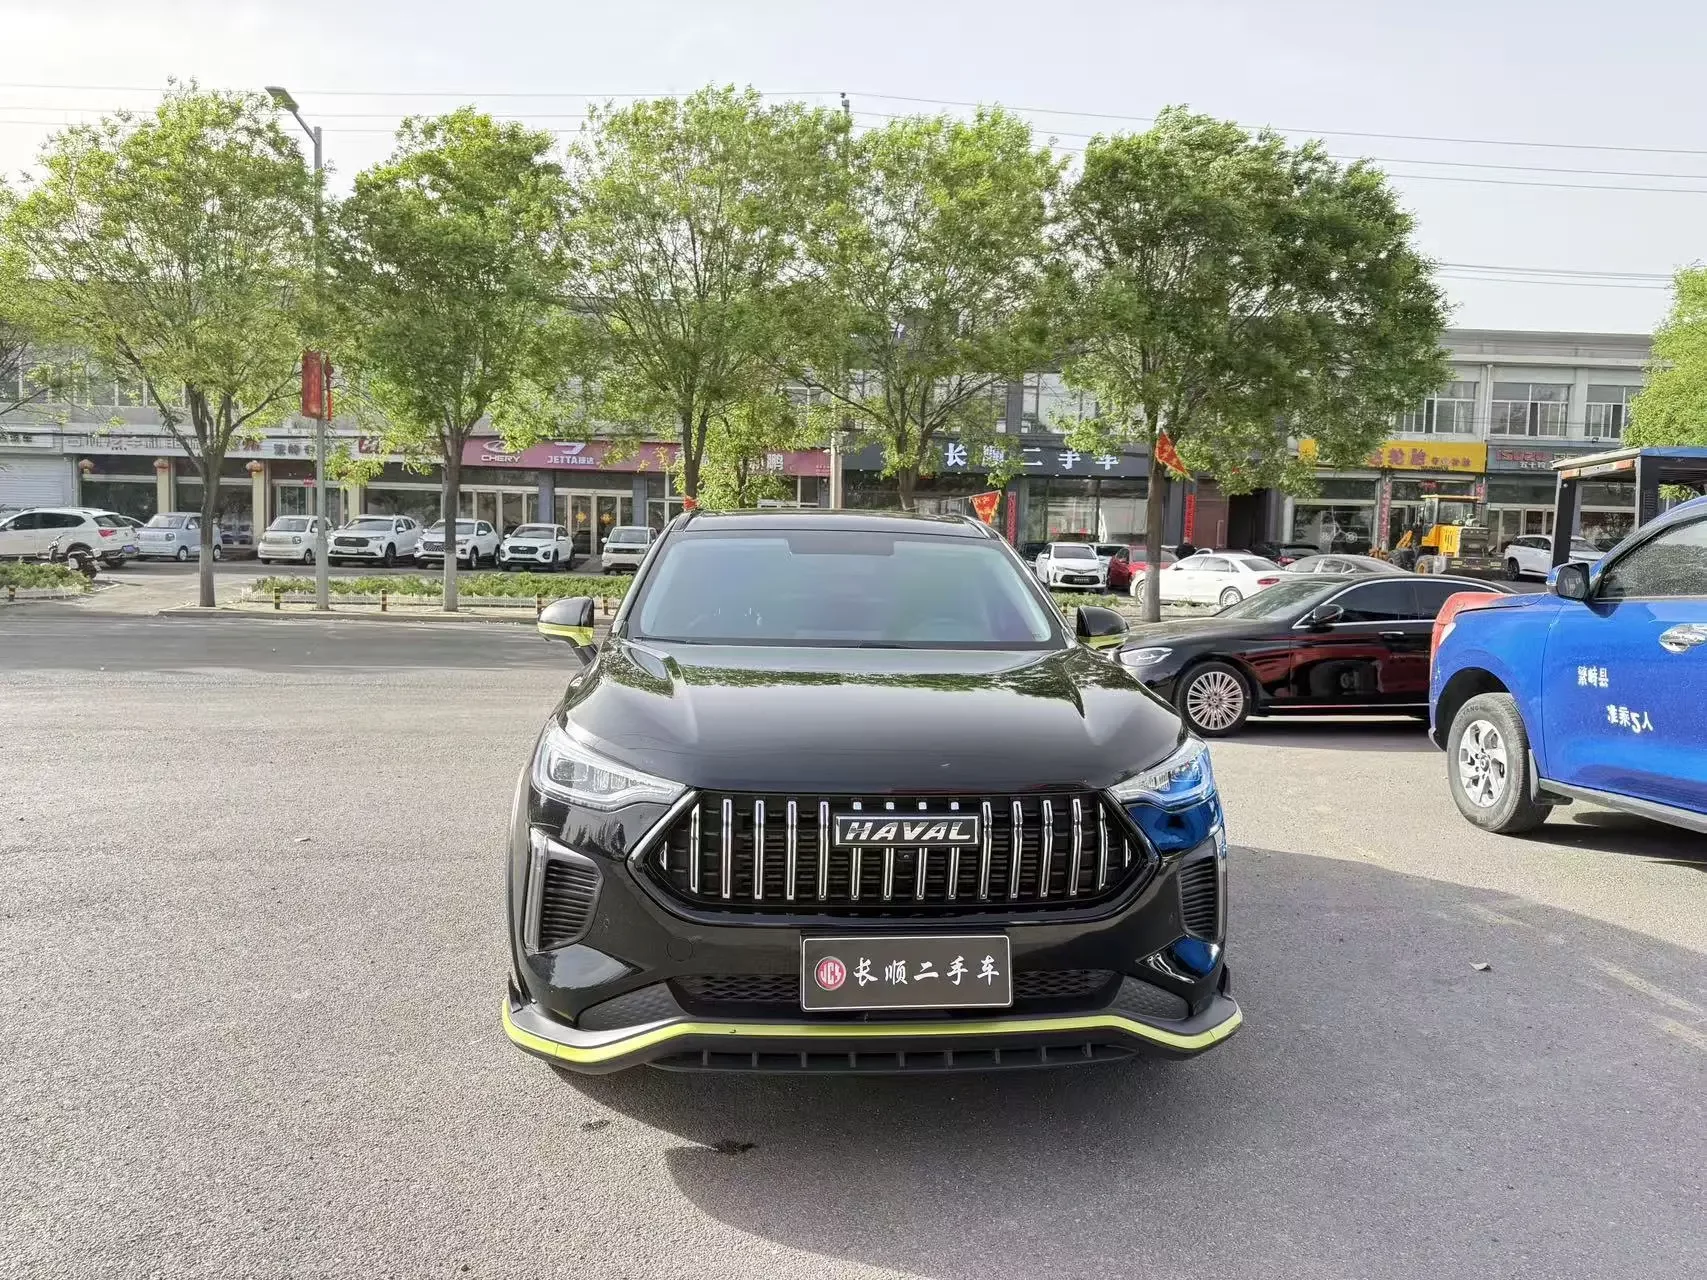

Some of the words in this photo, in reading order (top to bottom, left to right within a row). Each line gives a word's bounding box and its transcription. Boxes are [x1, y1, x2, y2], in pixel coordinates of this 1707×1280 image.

[481, 455, 521, 463] CHERY
[845, 822, 971, 840] HAVAL
[853, 955, 1000, 987] 长顺二手车
